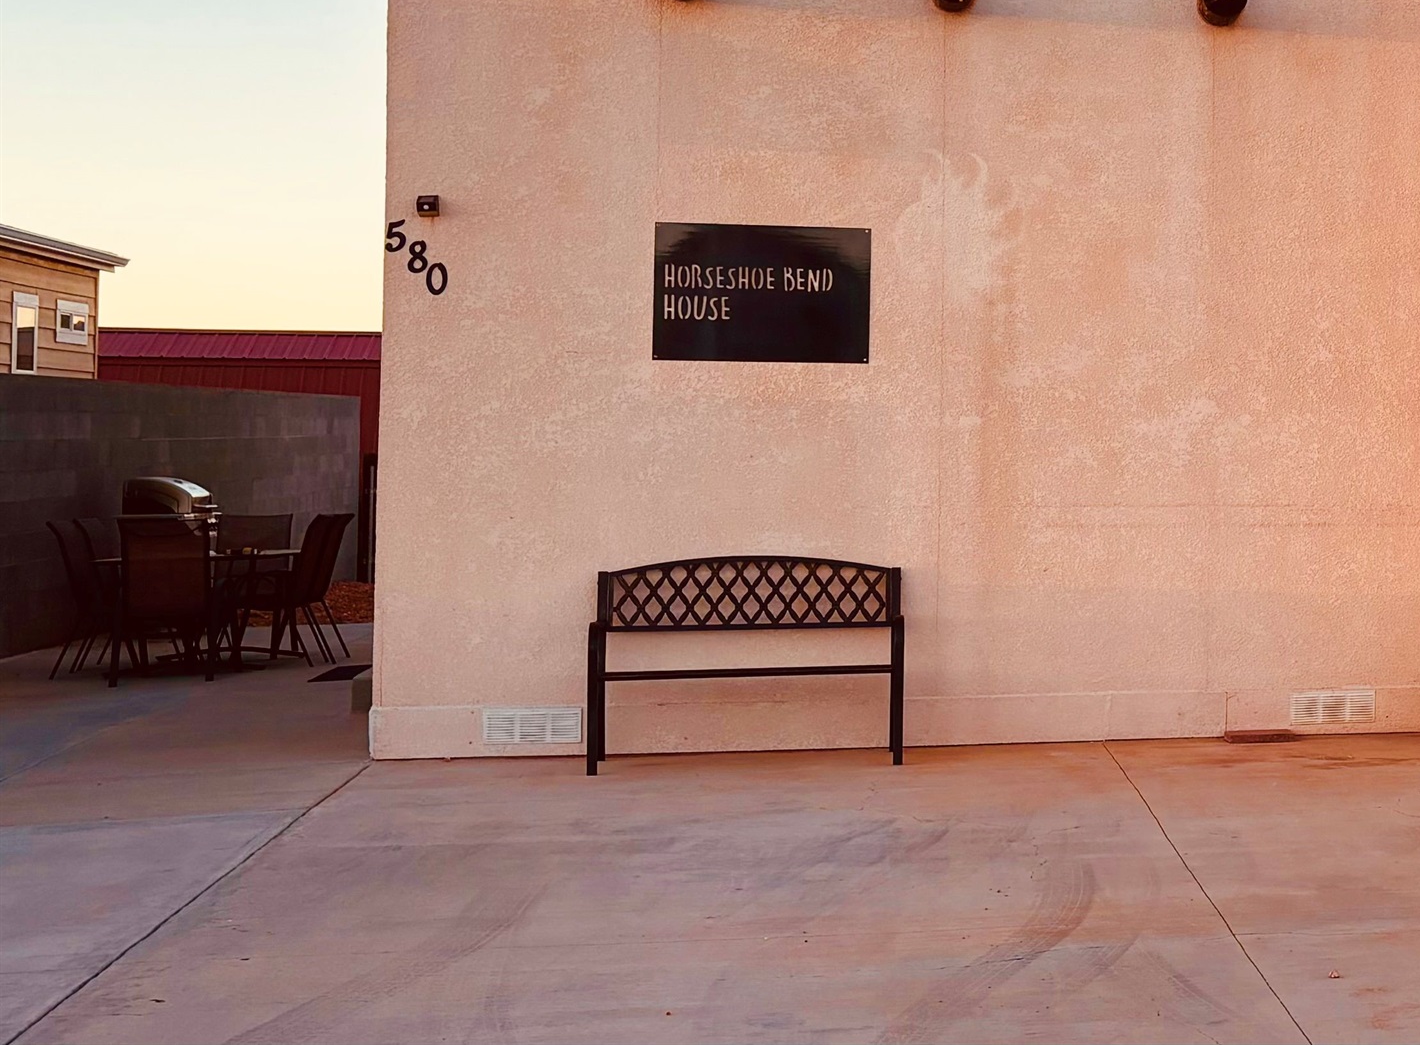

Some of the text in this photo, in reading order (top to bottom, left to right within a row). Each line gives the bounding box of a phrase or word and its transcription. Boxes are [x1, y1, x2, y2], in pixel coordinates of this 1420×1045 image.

[385, 219, 448, 295] 580
[664, 263, 833, 292] HORSESHOE BEND
[663, 294, 731, 321] HOUSE
